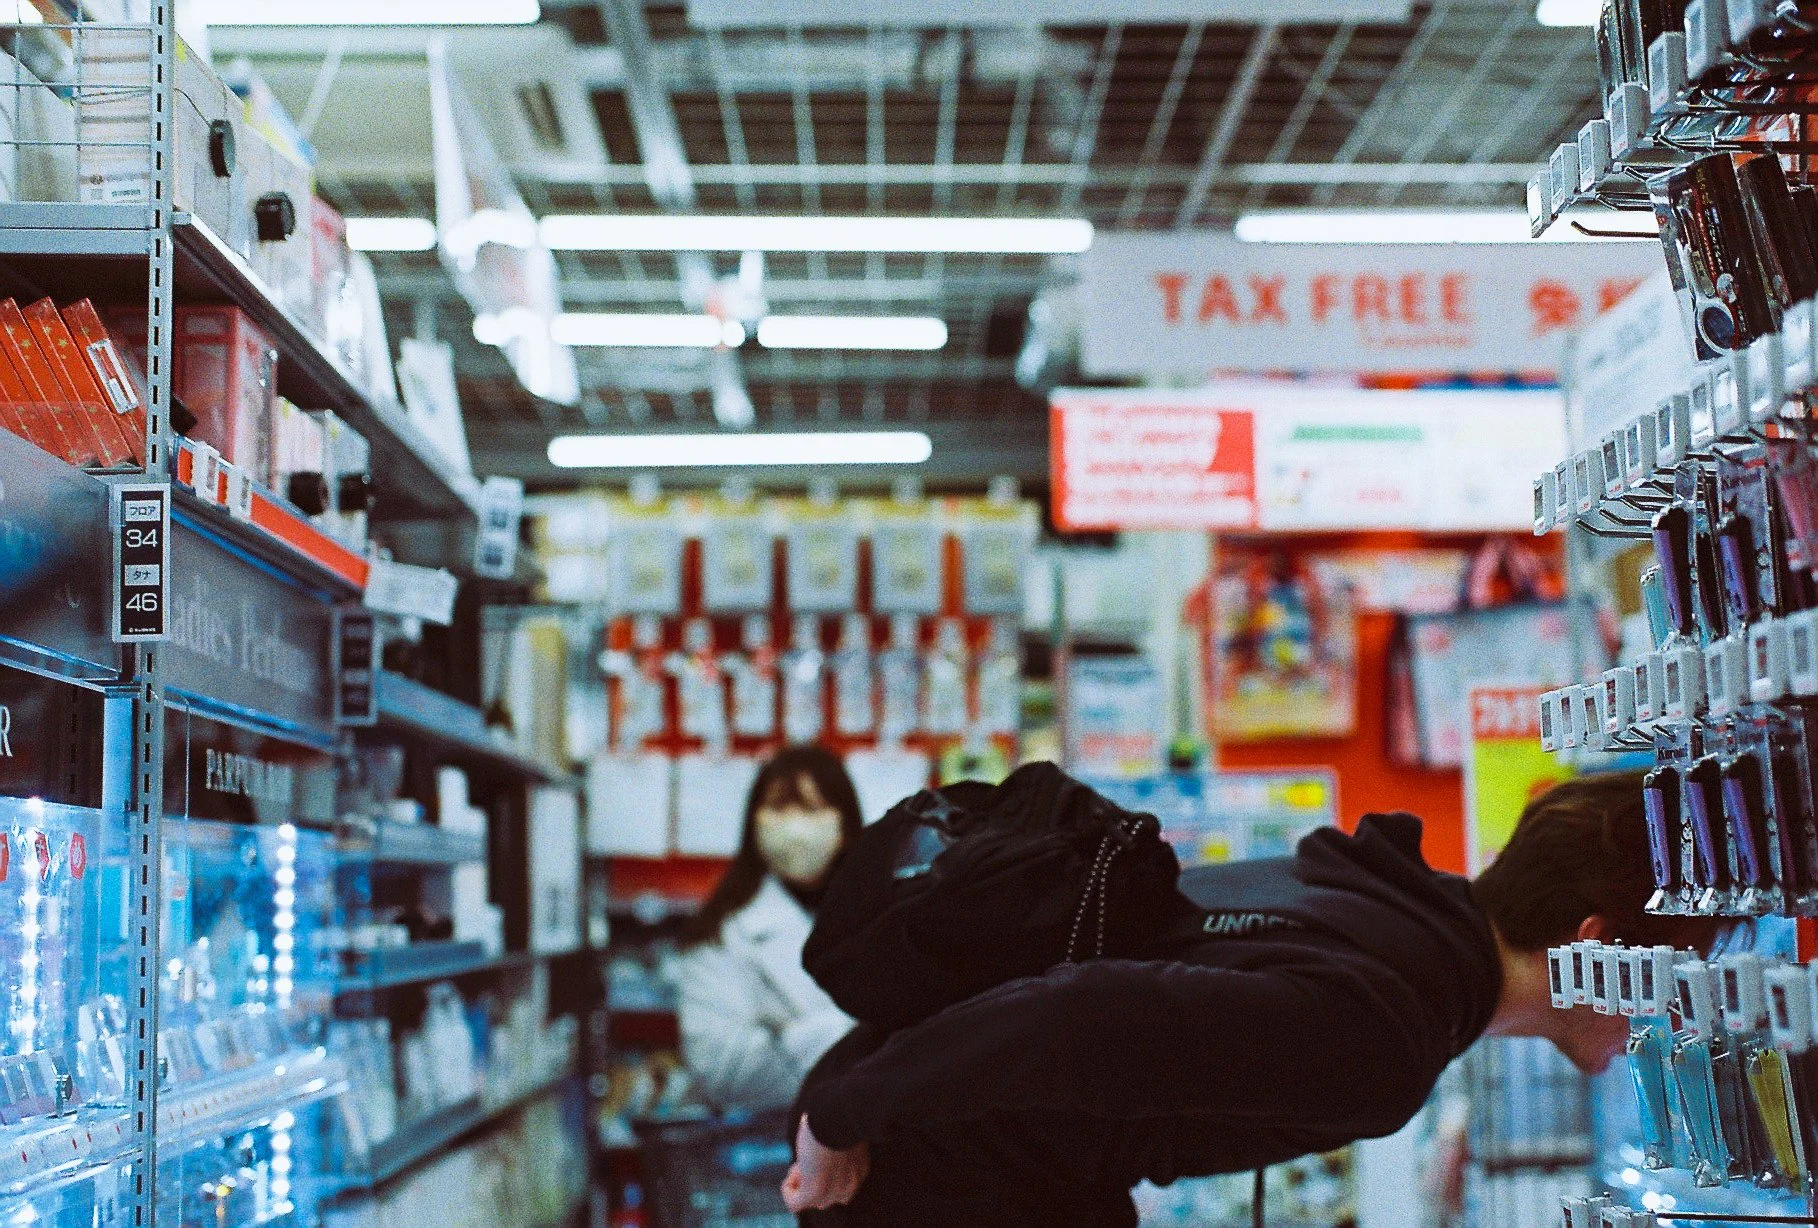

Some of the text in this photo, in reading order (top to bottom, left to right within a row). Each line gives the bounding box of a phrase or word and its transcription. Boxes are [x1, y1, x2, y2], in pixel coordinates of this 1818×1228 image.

[1156, 274, 1286, 324] TAX
[1311, 274, 1472, 324] FREE
[129, 505, 156, 516] フロア
[126, 528, 158, 548] 34
[132, 569, 152, 581] タナ
[126, 592, 158, 612] 46
